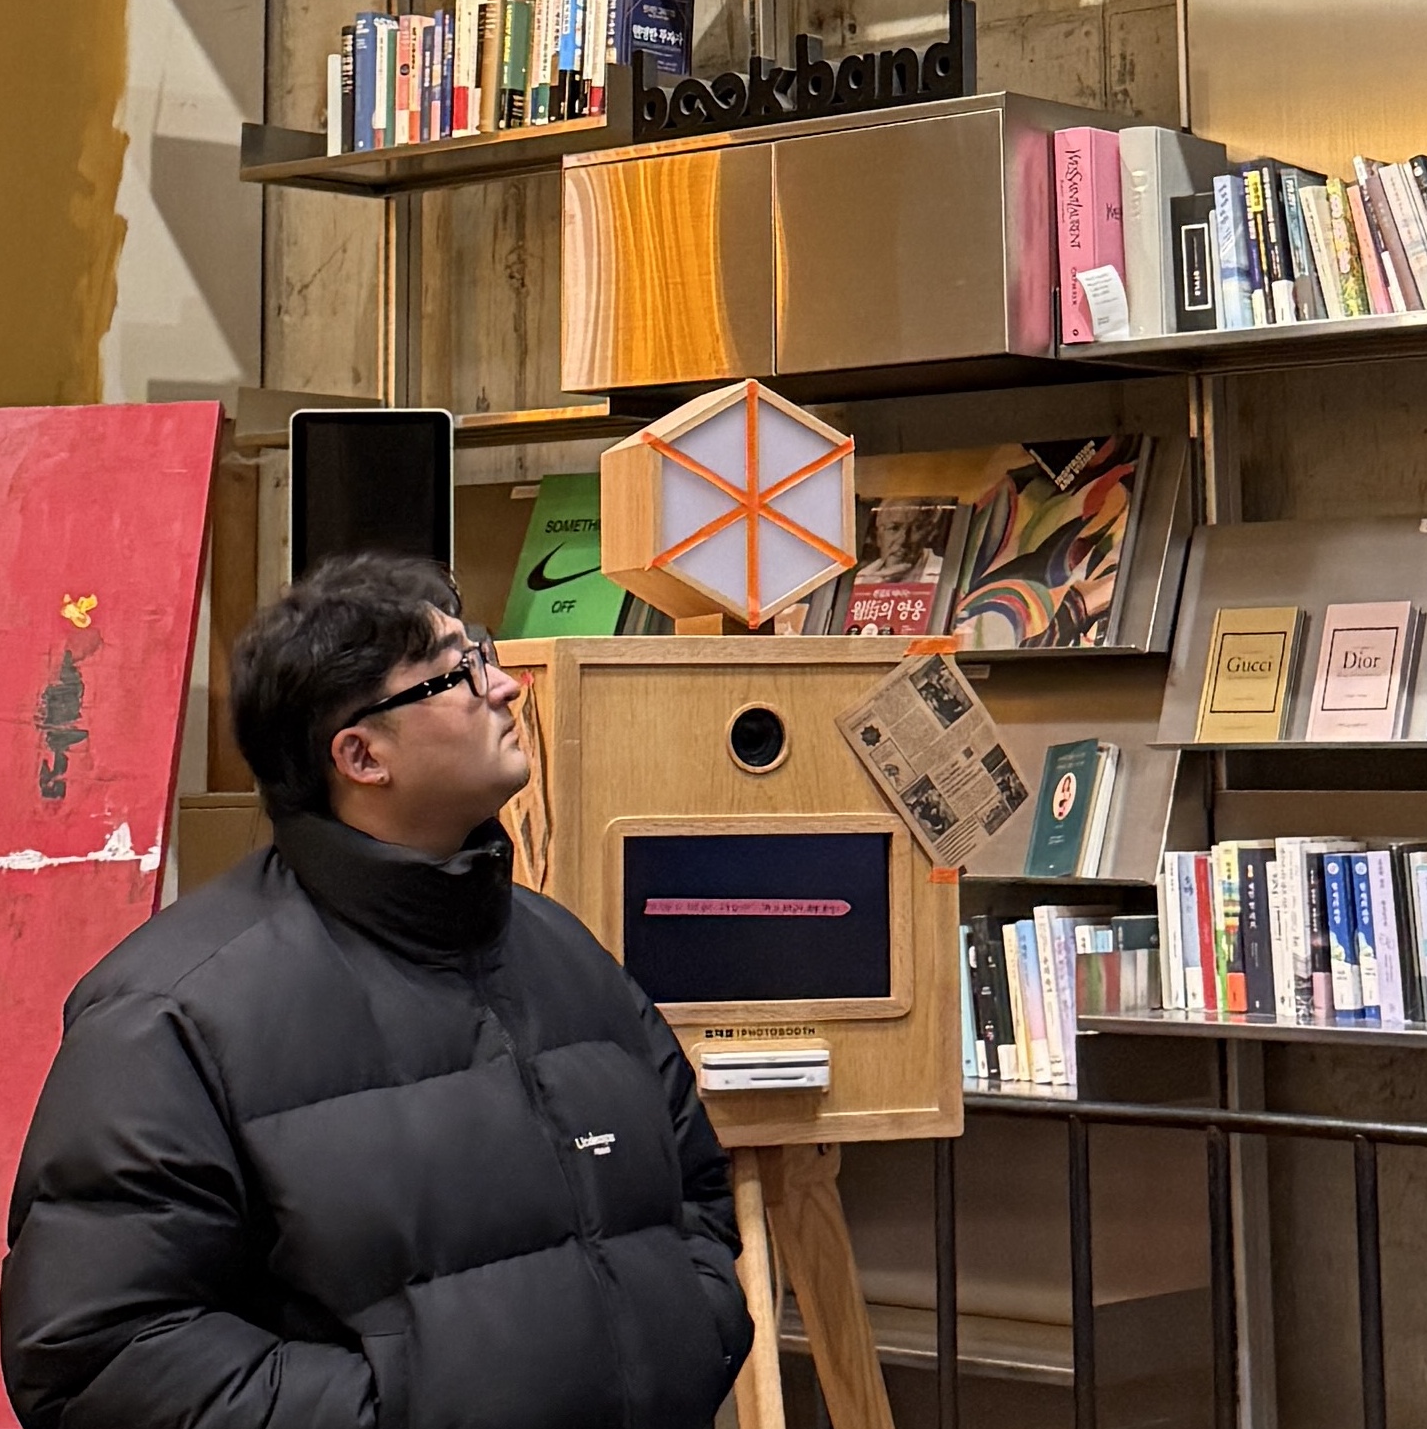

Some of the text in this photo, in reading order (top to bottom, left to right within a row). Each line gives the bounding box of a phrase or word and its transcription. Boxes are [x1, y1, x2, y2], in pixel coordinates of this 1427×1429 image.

[545, 518, 601, 534] SOMETH
[551, 599, 577, 614] OFF
[897, 599, 927, 621] 영웅
[1226, 655, 1273, 673] Gucci
[1343, 648, 1382, 669] Dior
